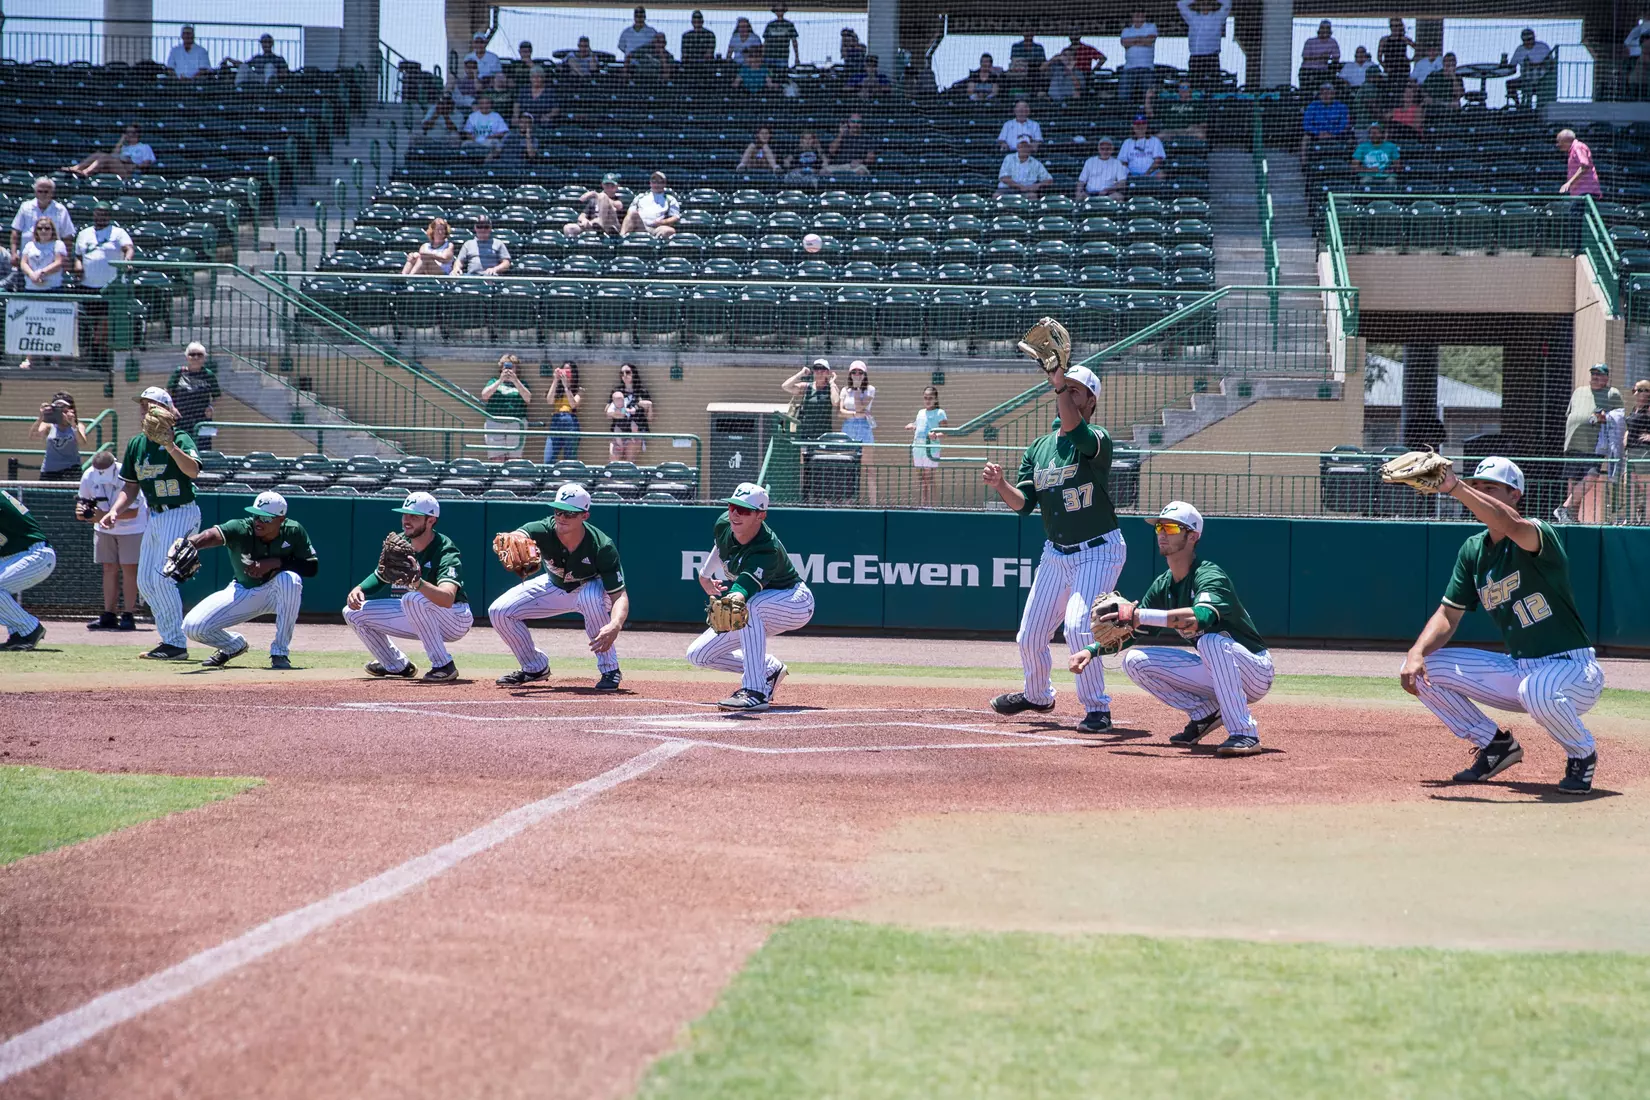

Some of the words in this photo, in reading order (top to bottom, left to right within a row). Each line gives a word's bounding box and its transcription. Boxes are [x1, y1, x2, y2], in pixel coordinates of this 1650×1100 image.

[25, 322, 56, 336] The
[18, 337, 62, 352] Office
[154, 479, 180, 498] 22
[1033, 458, 1079, 491] USF
[1063, 482, 1093, 512] 37
[786, 553, 980, 587] McEwen
[992, 557, 1039, 588] Fi
[1512, 592, 1552, 628] 12
